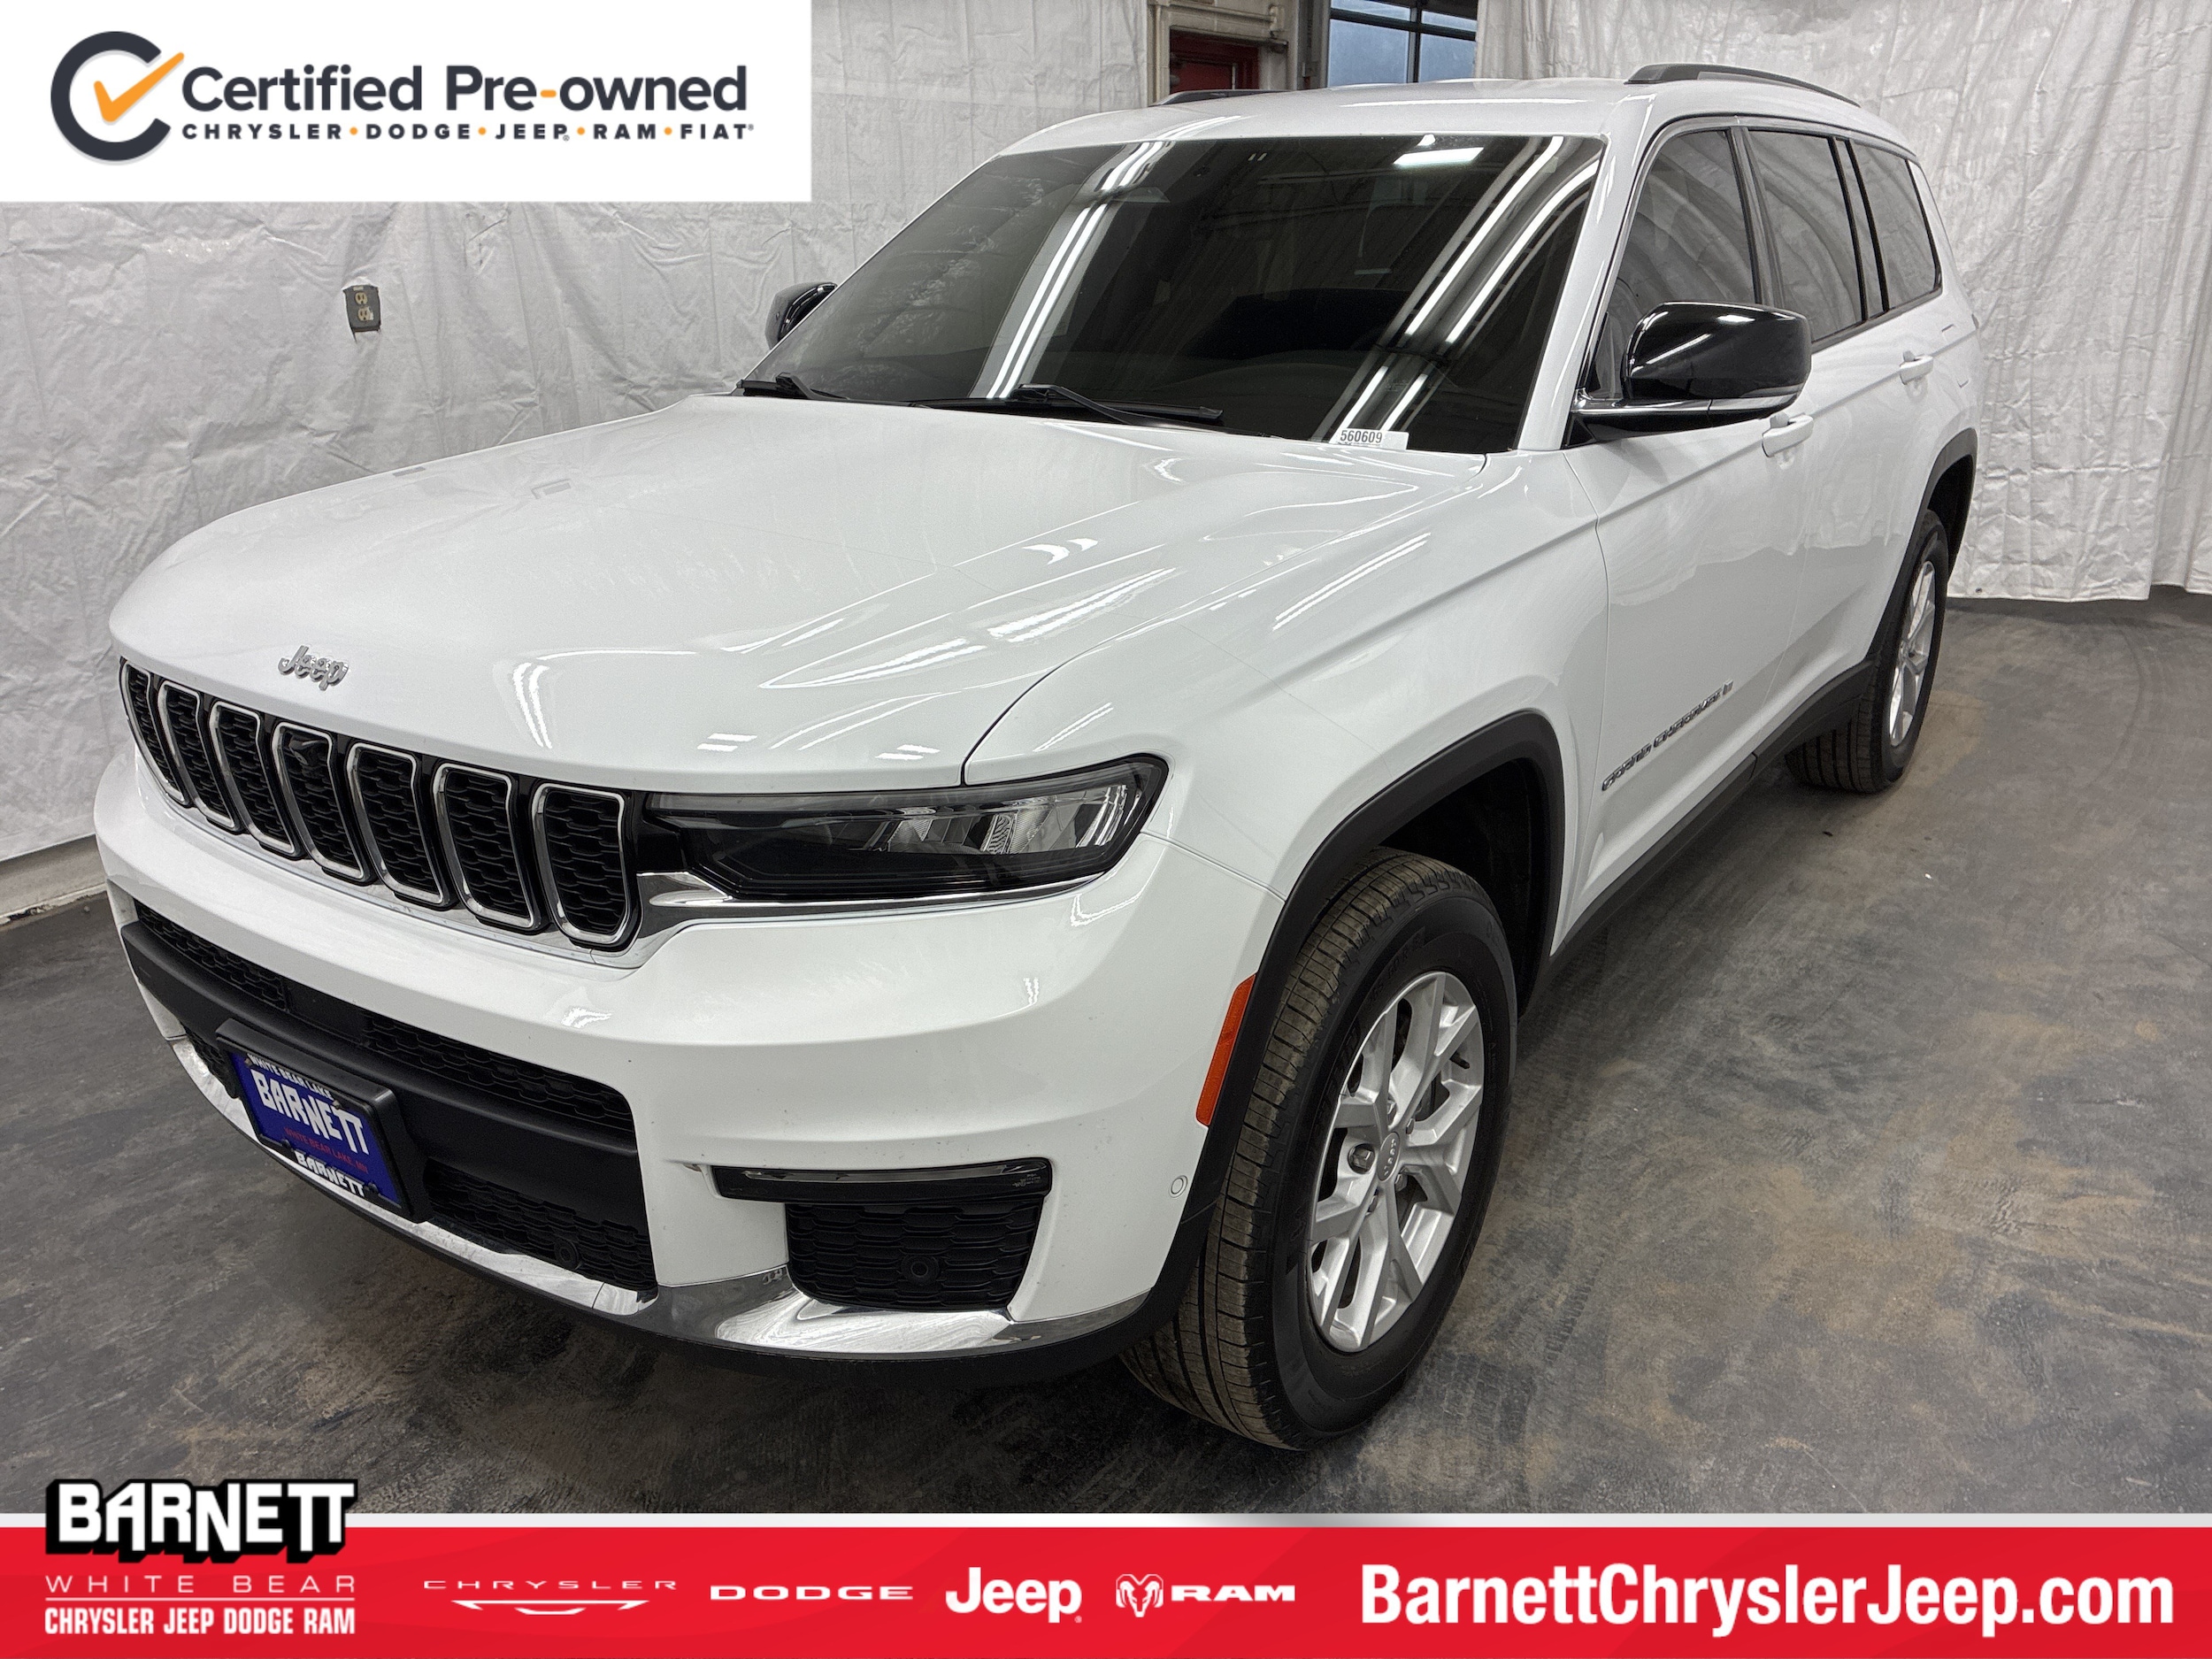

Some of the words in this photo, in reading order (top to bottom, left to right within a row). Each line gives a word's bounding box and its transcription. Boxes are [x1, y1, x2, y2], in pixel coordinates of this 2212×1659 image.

[1340, 429, 1383, 444] 560609
[277, 644, 349, 691] Jeep
[279, 1067, 307, 1088] BEAR
[250, 1069, 370, 1156] BARNETT
[294, 1150, 365, 1197] BARNETT
